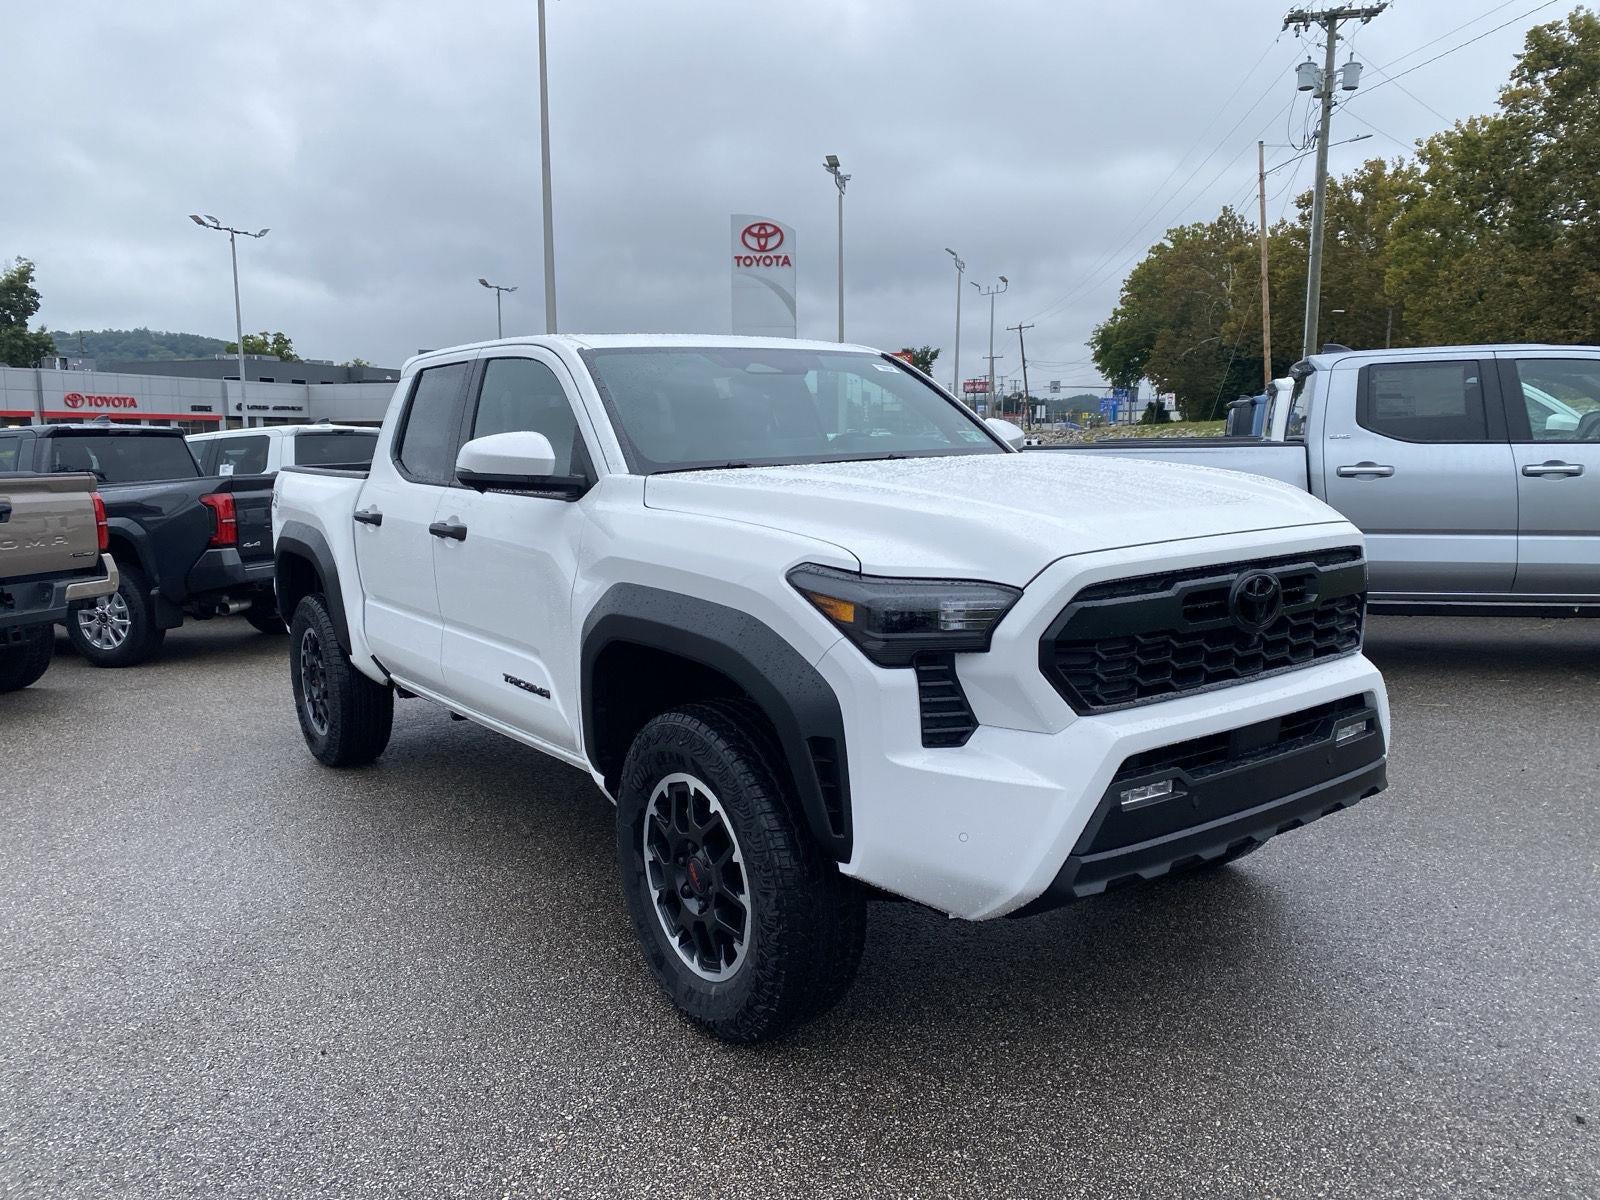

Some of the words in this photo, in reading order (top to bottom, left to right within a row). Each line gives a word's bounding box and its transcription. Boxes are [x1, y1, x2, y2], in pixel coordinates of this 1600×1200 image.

[734, 255, 792, 267] TOYOTA
[85, 395, 138, 408] TOYOTA
[502, 672, 551, 700] TACOMA
